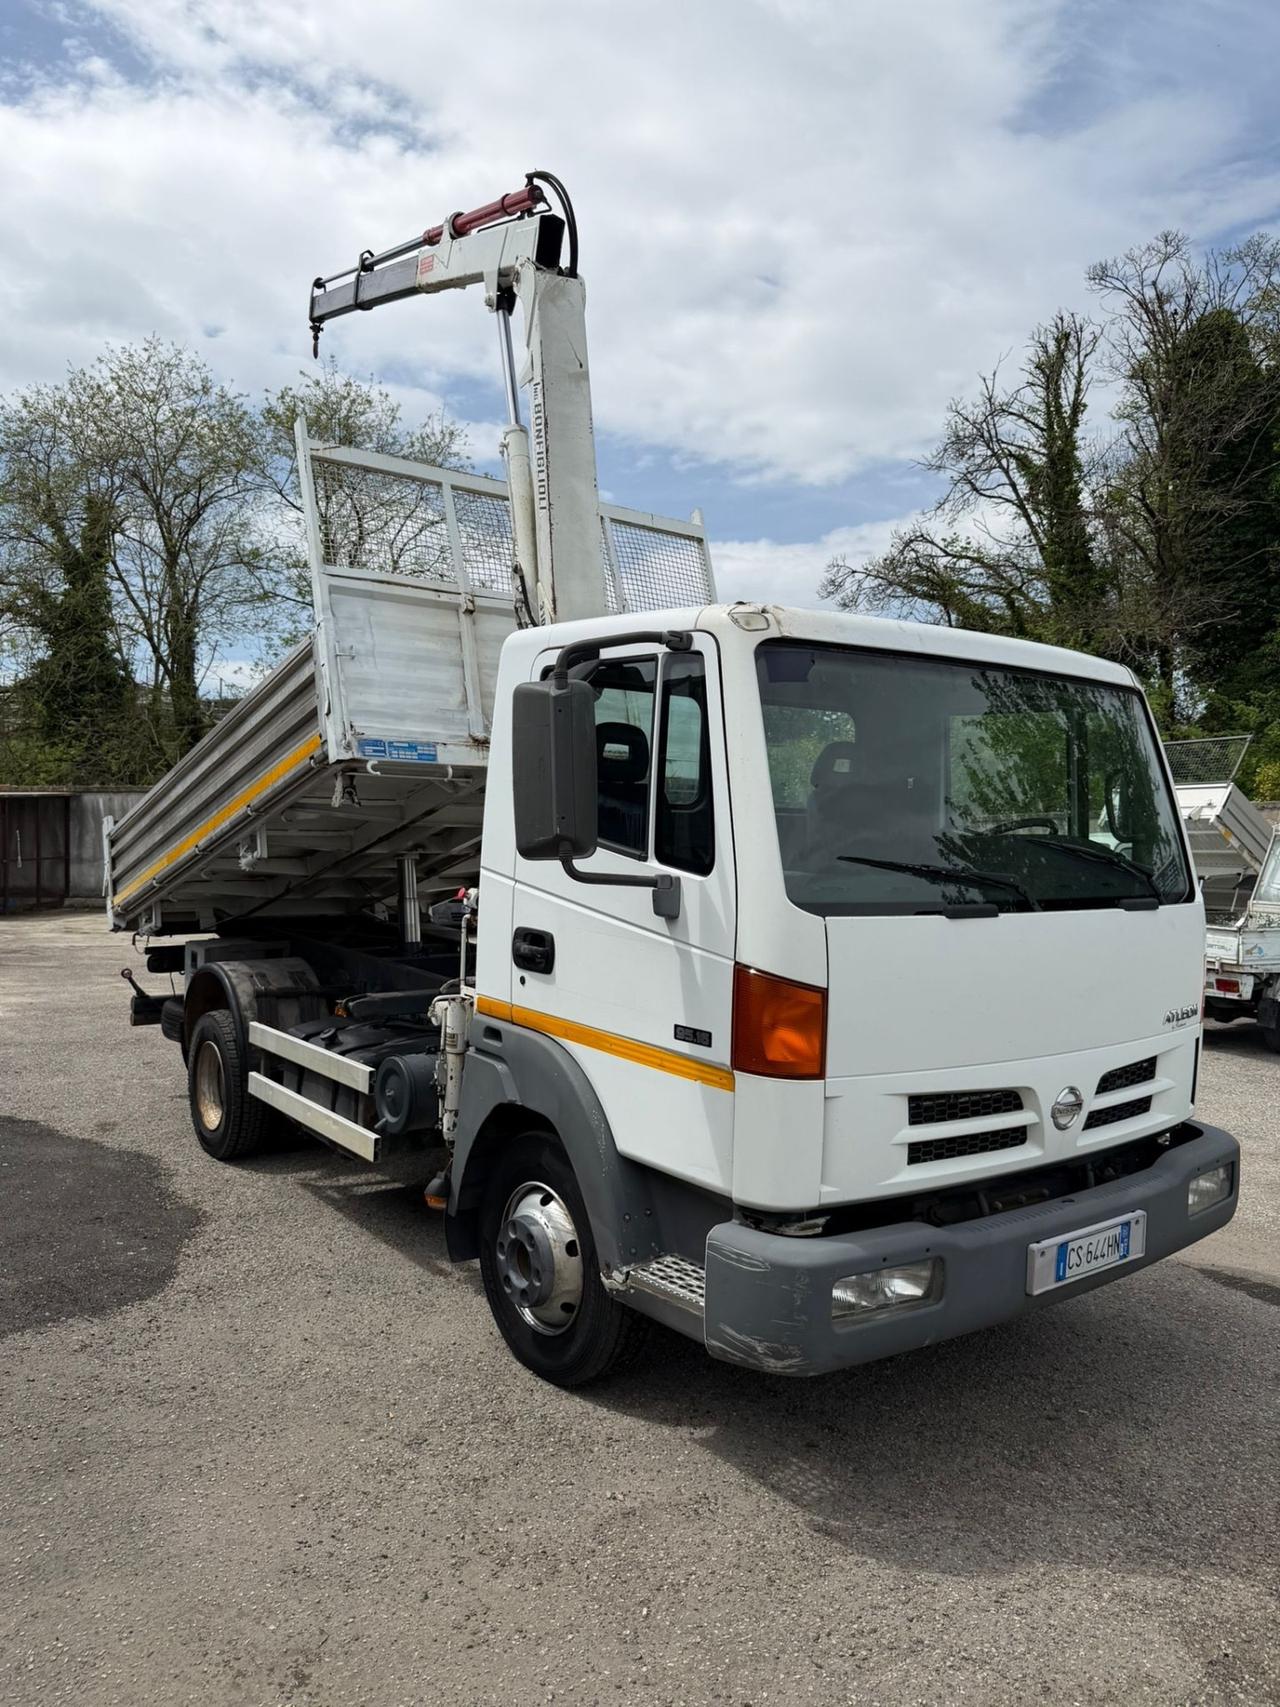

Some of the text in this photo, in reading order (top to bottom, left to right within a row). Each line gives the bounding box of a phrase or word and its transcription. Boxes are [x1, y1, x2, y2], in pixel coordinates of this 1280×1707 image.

[534, 403, 547, 510] BONFIGLIOLI
[1067, 1246, 1083, 1270] CS
[1086, 1231, 1121, 1264] 644HN
